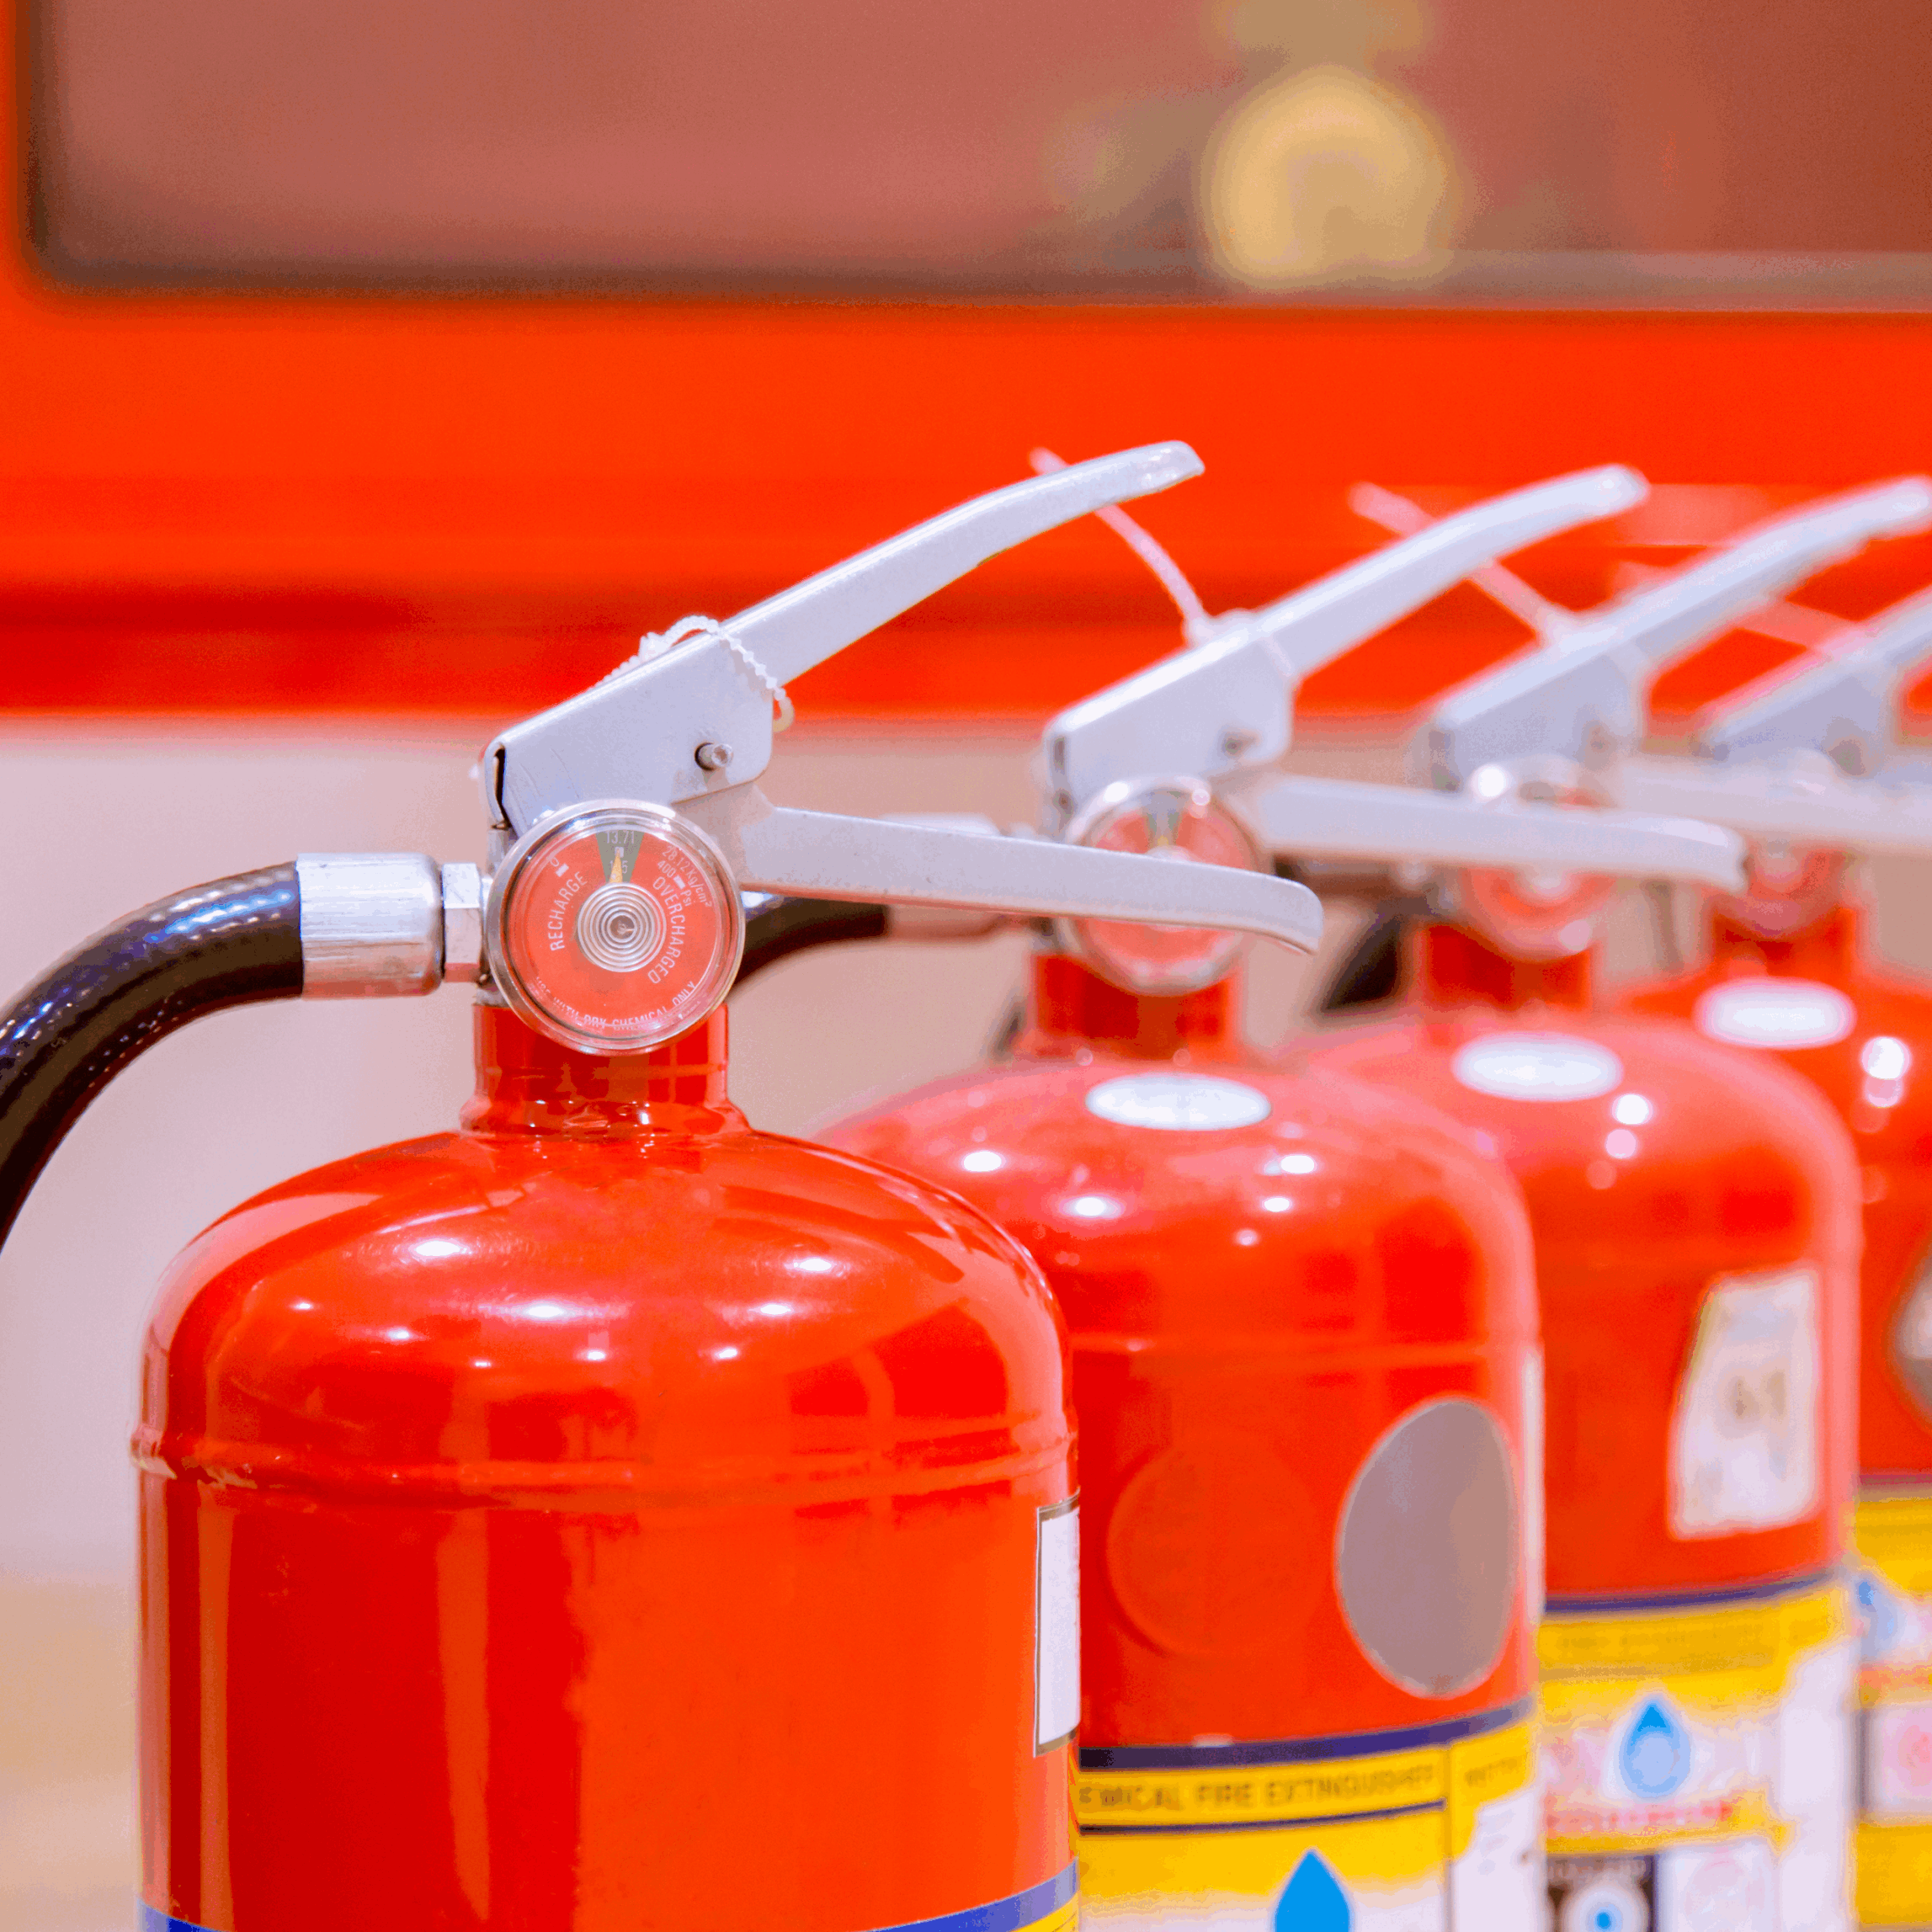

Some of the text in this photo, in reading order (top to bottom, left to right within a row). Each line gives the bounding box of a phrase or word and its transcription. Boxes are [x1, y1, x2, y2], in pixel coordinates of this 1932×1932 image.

[607, 830, 635, 844] 13.71
[609, 860, 629, 875] 15
[657, 860, 677, 878] 400
[662, 844, 690, 872] 28.12
[548, 871, 588, 952] RECHARGE
[647, 876, 686, 985] OVERCHARGED
[672, 980, 697, 1006] ONLY
